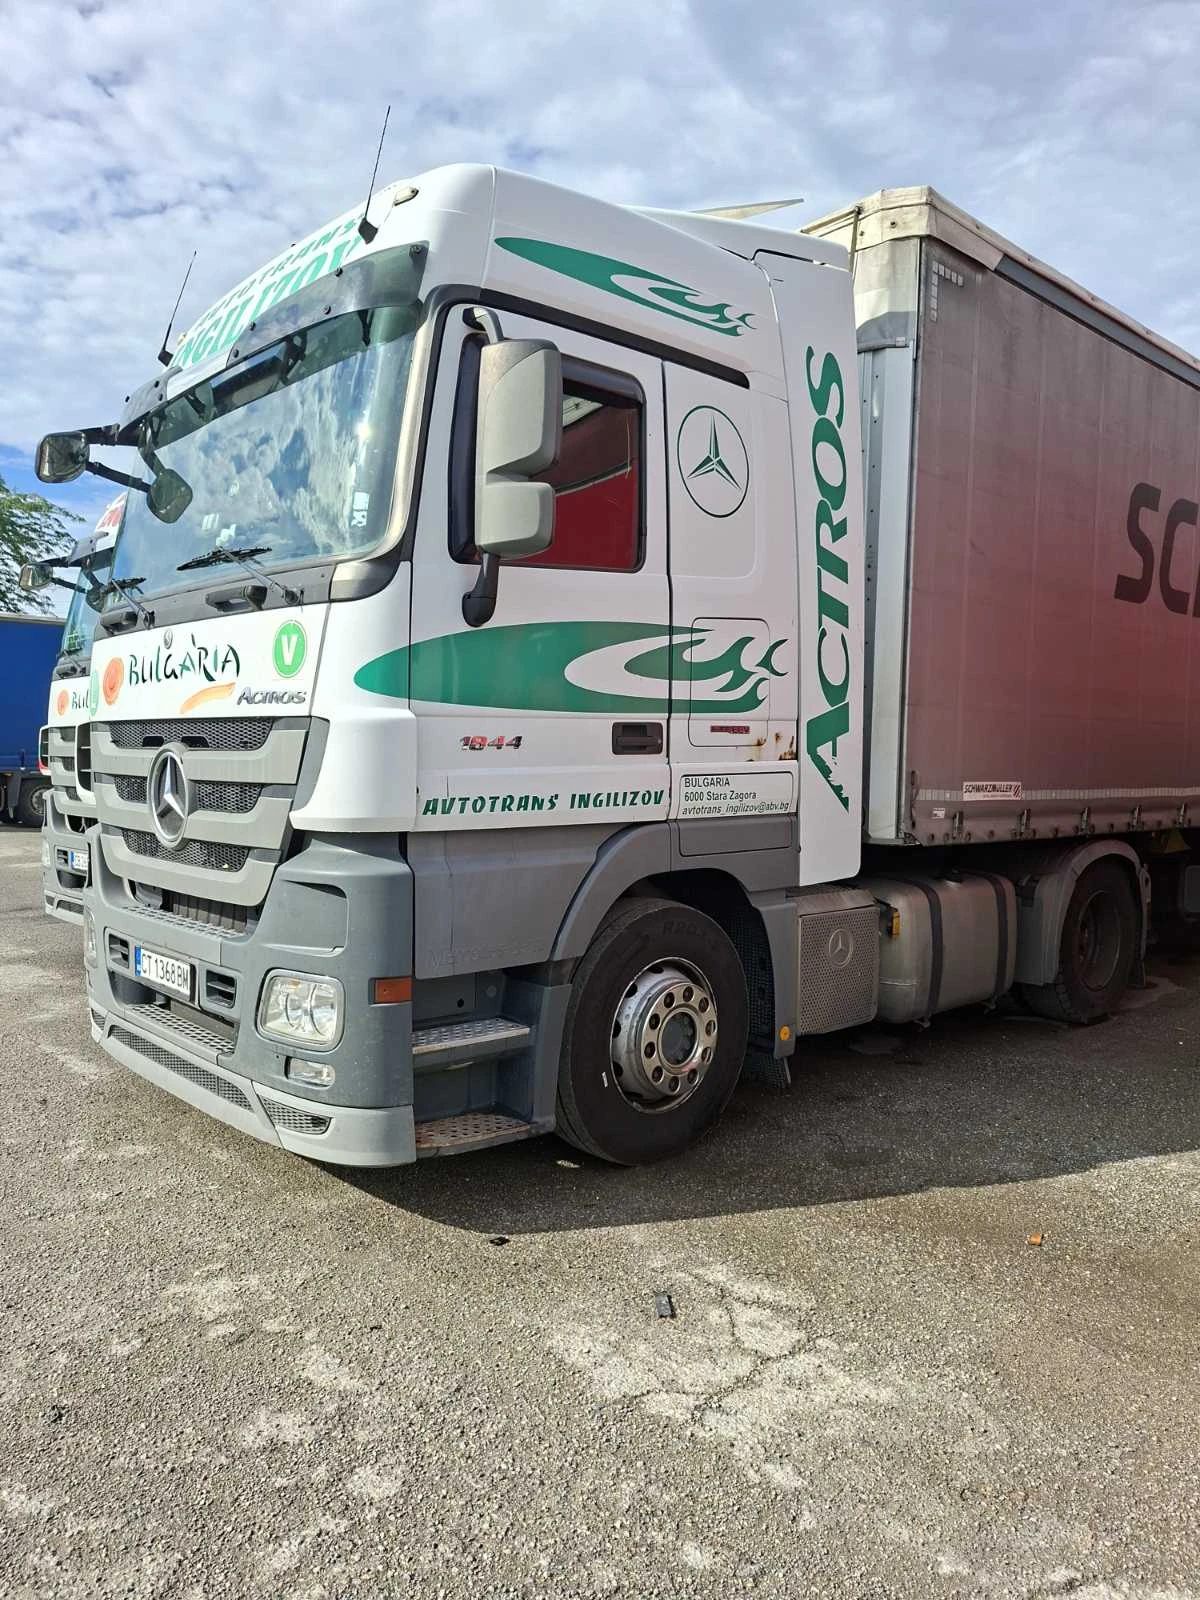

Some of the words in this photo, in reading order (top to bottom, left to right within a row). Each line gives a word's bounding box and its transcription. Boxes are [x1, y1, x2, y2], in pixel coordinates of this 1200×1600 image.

[1114, 482, 1200, 618] SC
[806, 344, 850, 813] ACTROS
[280, 633, 298, 667] V
[459, 736, 523, 751] 1844
[684, 777, 731, 788] BULGARIA
[569, 789, 665, 810] INGILIZOV
[684, 791, 704, 802] 6000
[706, 790, 728, 801] Stara
[729, 789, 757, 802] Zagora
[682, 801, 790, 816] avtotrans_ingilizov@abv.bg
[154, 957, 176, 985] 1368
